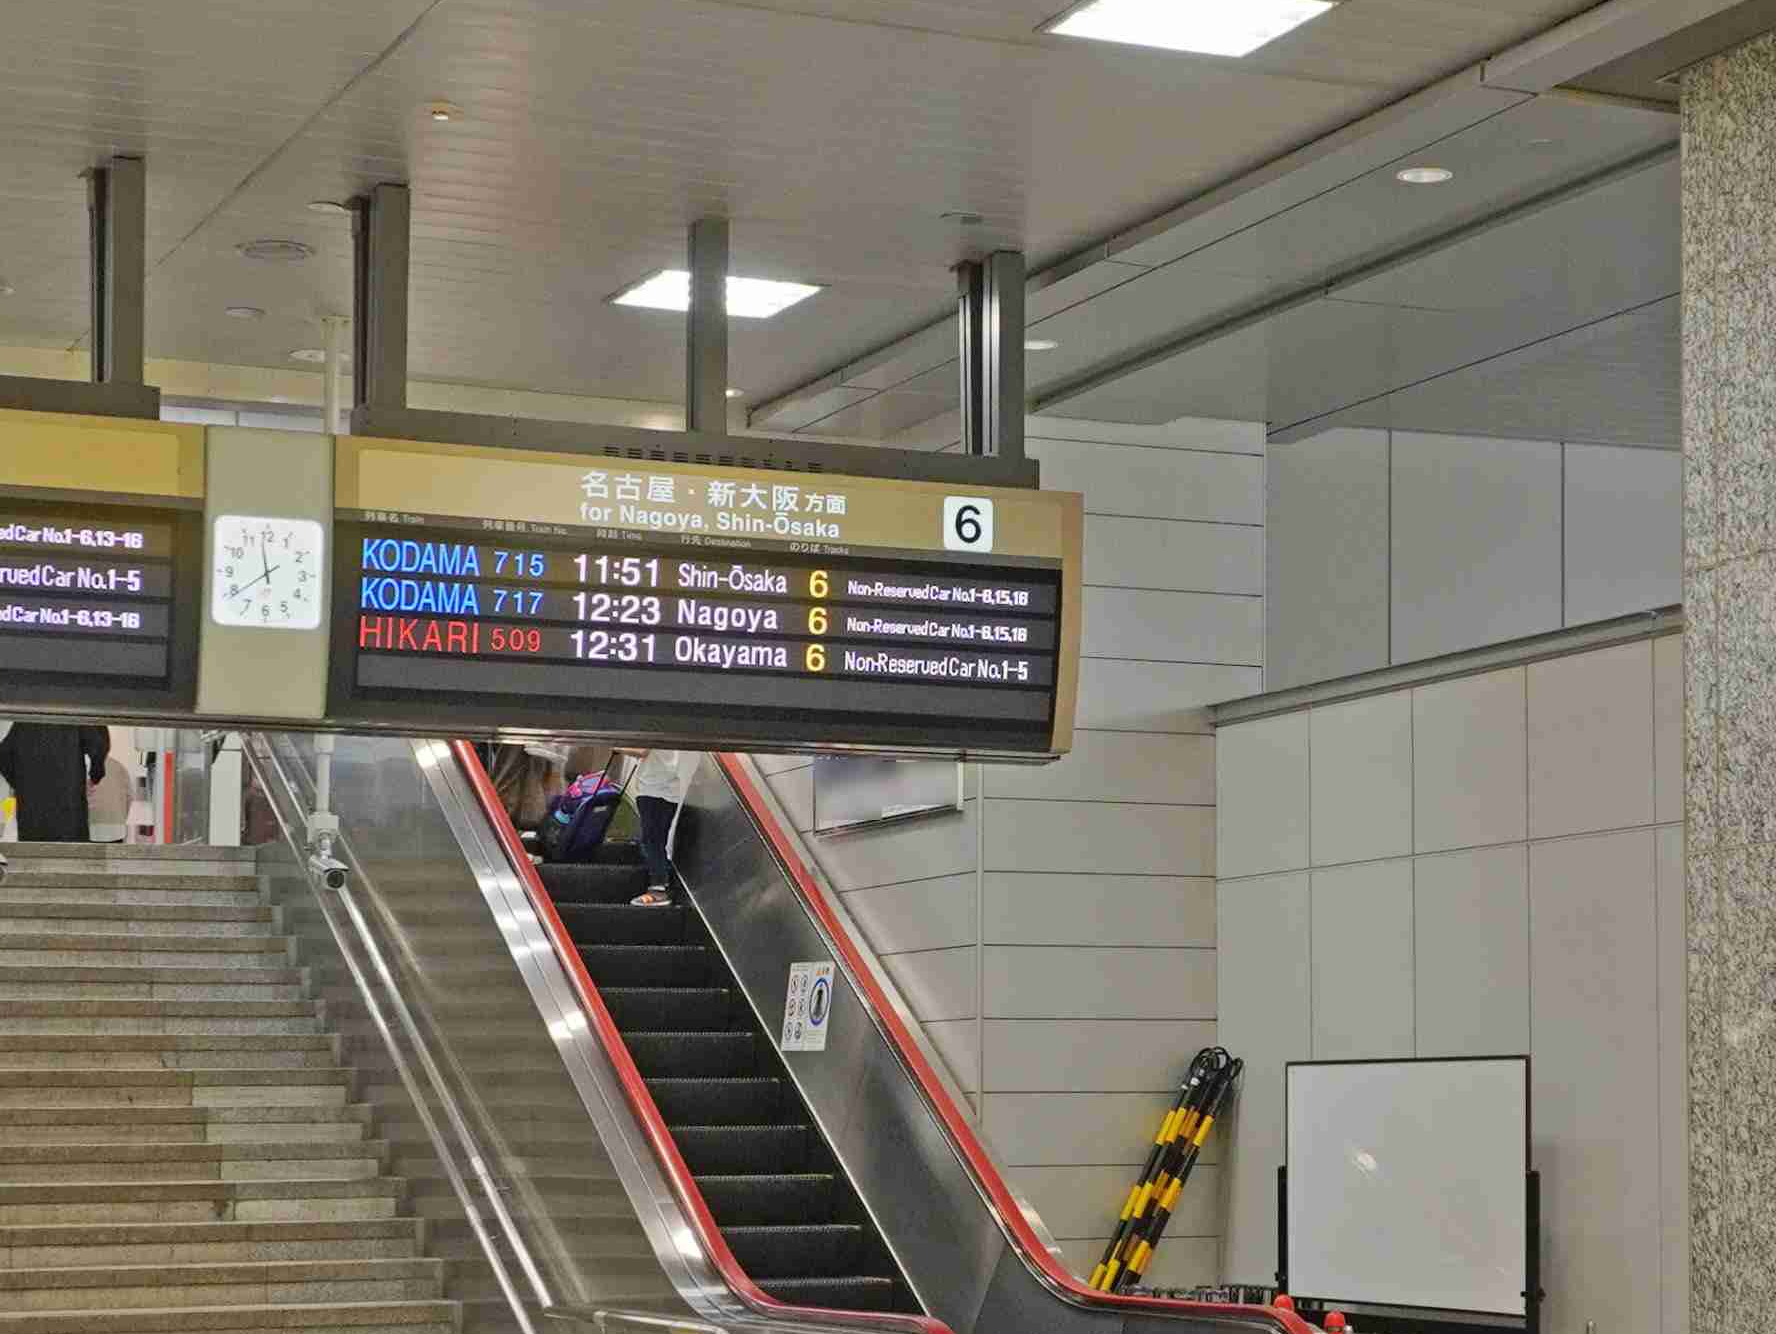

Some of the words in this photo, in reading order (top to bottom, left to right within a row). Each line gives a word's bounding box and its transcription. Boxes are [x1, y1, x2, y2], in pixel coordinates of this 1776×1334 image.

[580, 503, 613, 522] for
[619, 505, 709, 530] Nagoya,
[716, 510, 840, 539] Shin-Ōsaka
[954, 504, 982, 543] 6
[41, 563, 75, 588] Car
[362, 538, 480, 577] KODAMA
[494, 550, 544, 578] 715
[574, 554, 660, 588] 11:51
[678, 563, 787, 595] Shin-Ōsaka
[809, 570, 828, 598] 6
[361, 578, 479, 616] KODAMA
[494, 589, 544, 615] 717
[573, 592, 660, 625] 12:23
[677, 599, 777, 634] Nagoya
[808, 606, 827, 635] 6
[359, 616, 479, 654] HIKARI
[490, 628, 541, 652] 509
[570, 630, 657, 663] 12:31
[675, 637, 787, 670] Okayama
[805, 643, 826, 672] 6
[949, 656, 976, 677] Car
